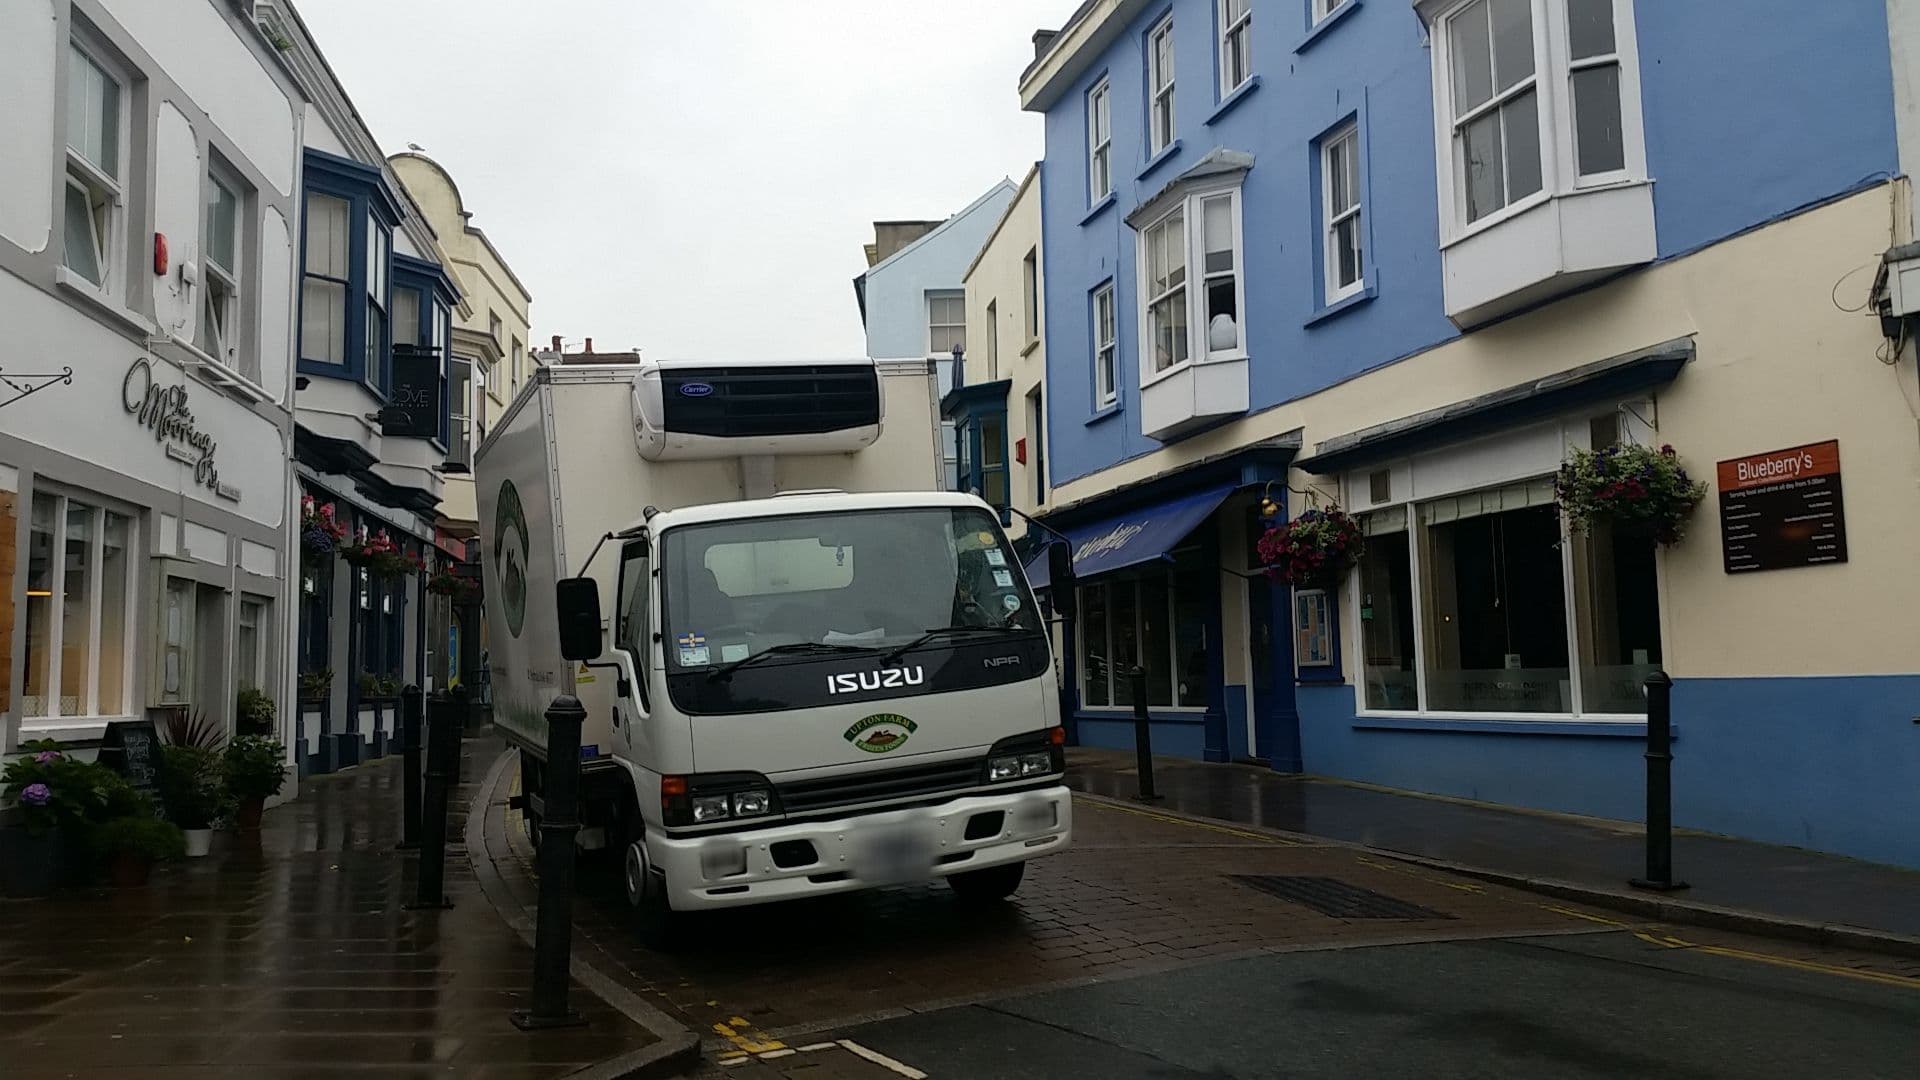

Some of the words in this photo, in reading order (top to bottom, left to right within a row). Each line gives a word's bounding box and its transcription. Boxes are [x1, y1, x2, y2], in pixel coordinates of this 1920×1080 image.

[169, 385, 191, 418] The
[1738, 451, 1813, 481] Blueberry's
[983, 656, 1021, 669] NPR
[827, 665, 924, 695] ISUZU
[850, 714, 881, 735] UPTON
[884, 714, 911, 728] FARM
